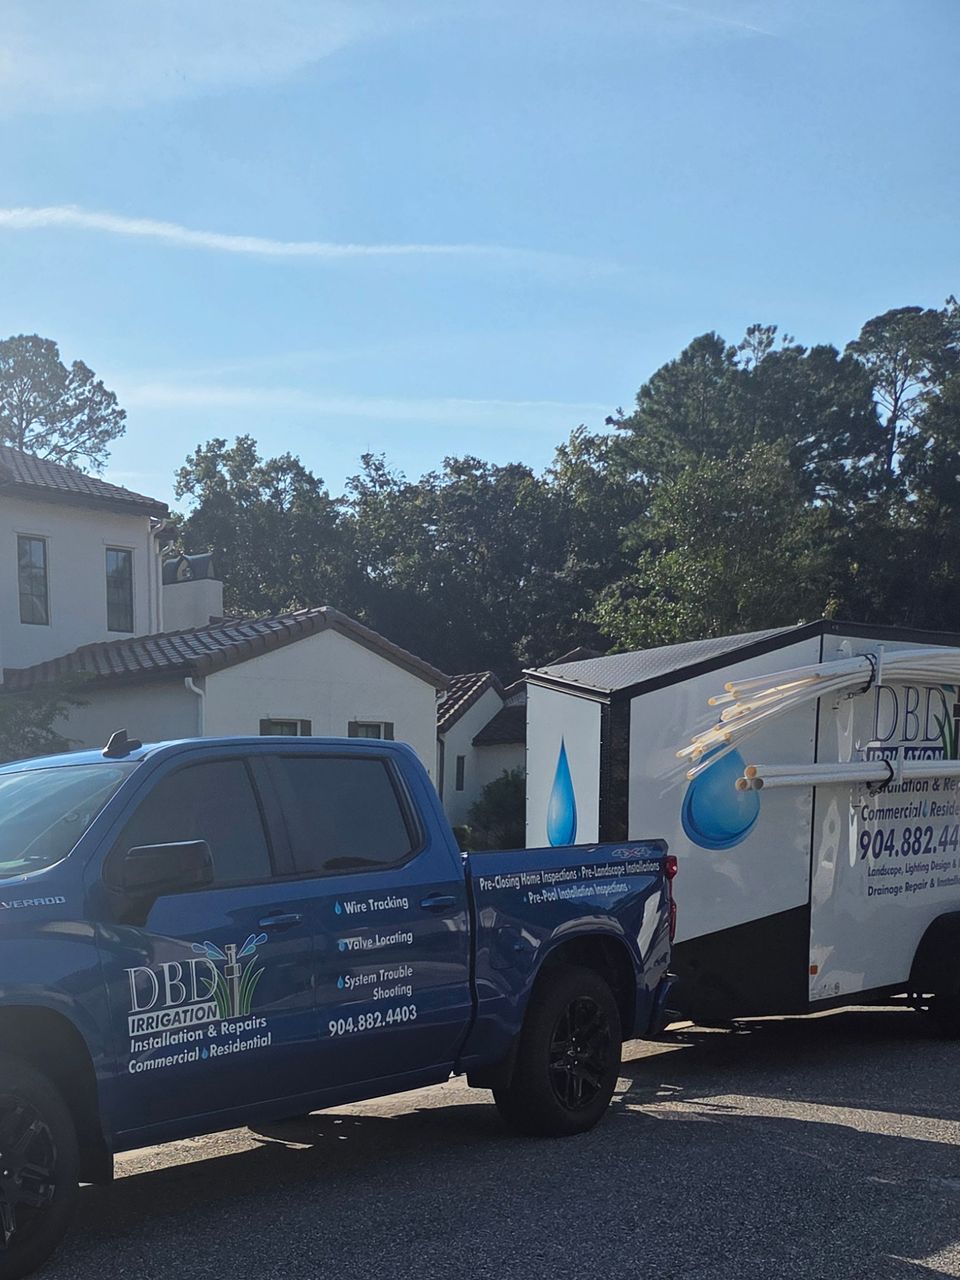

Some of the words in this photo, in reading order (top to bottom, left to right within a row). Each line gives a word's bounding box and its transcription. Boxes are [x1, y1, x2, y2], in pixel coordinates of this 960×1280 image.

[872, 685, 947, 742] DBD
[932, 777, 940, 791] &
[861, 801, 922, 821] Commercial
[480, 874, 520, 891] Pre-Closing
[520, 872, 541, 886] Home
[541, 868, 577, 885] Inspections
[581, 863, 625, 879] Pre-Landscape
[626, 860, 660, 874] Installations
[905, 862, 929, 876] Lighting
[931, 859, 951, 872] Design
[528, 887, 558, 904] Pre-Pool
[557, 884, 595, 900] Installation
[594, 881, 628, 897] Inspections
[868, 884, 903, 896] Drainage
[905, 879, 928, 893] Repair
[344, 901, 367, 914] Wire
[368, 896, 409, 911] Tracking
[346, 937, 373, 950] Valve
[375, 931, 413, 945] Locating
[123, 958, 218, 1013] DBD
[344, 974, 377, 990] System
[380, 964, 413, 981] Trouble
[373, 984, 412, 1000] Shooting
[130, 1004, 218, 1034] IRRIGATION
[329, 1004, 417, 1037] 904.882.4403
[130, 1028, 203, 1053] Installation
[207, 1024, 217, 1038] &
[221, 1016, 267, 1035] Repairs
[128, 1046, 199, 1074] Commercial
[209, 1032, 271, 1058] Residential
